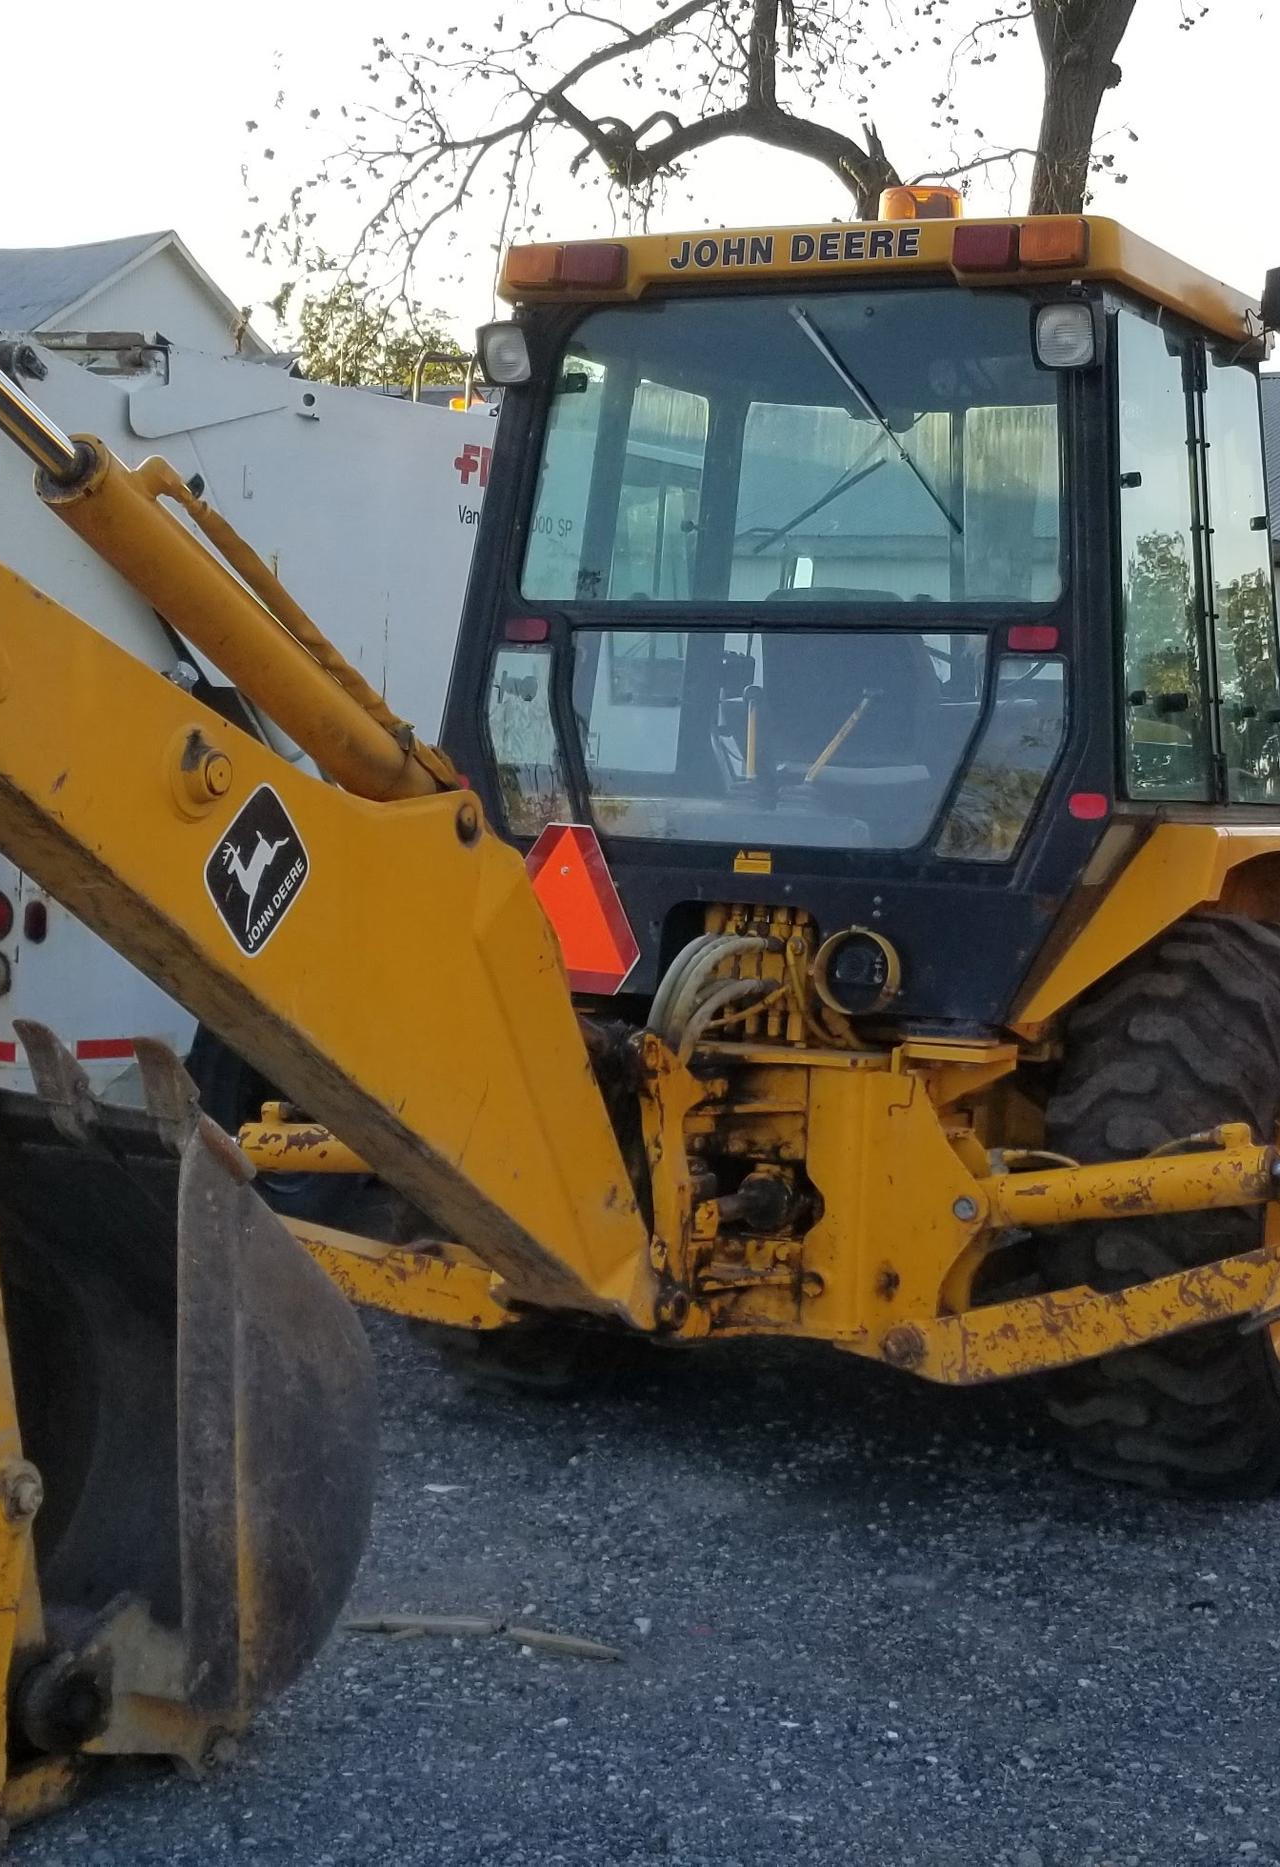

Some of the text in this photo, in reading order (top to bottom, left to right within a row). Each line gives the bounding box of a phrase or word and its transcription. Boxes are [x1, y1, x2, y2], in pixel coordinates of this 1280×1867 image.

[670, 228, 921, 270] JOHN DEERE
[558, 518, 573, 537] SP
[247, 857, 305, 948] JOHN DEERE
